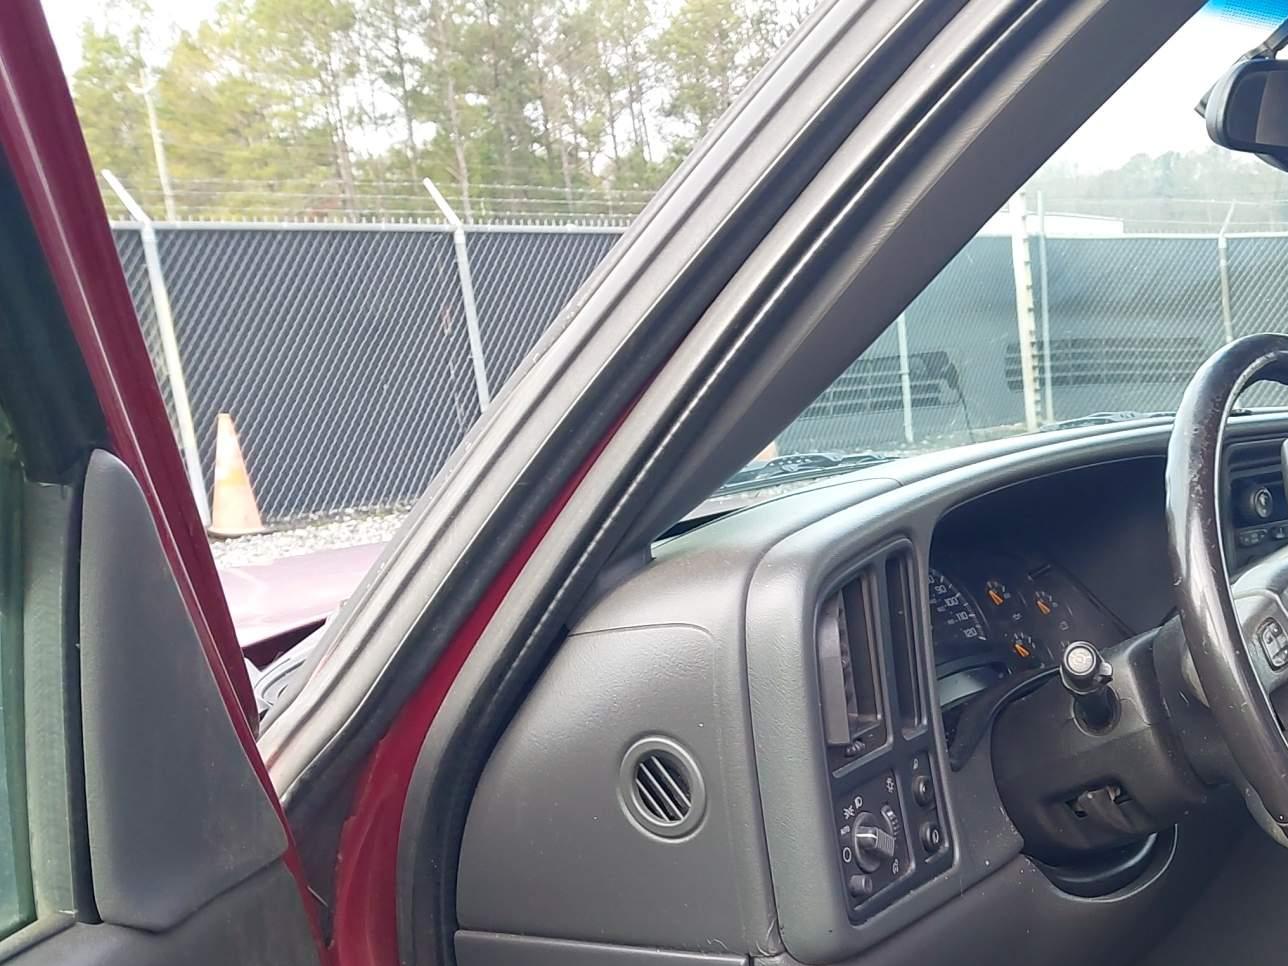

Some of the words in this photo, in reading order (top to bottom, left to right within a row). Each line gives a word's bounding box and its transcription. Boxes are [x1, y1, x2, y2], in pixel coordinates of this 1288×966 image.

[934, 584, 947, 594] 90
[944, 596, 959, 607] 100
[955, 611, 969, 621] 110
[963, 627, 978, 638] 120
